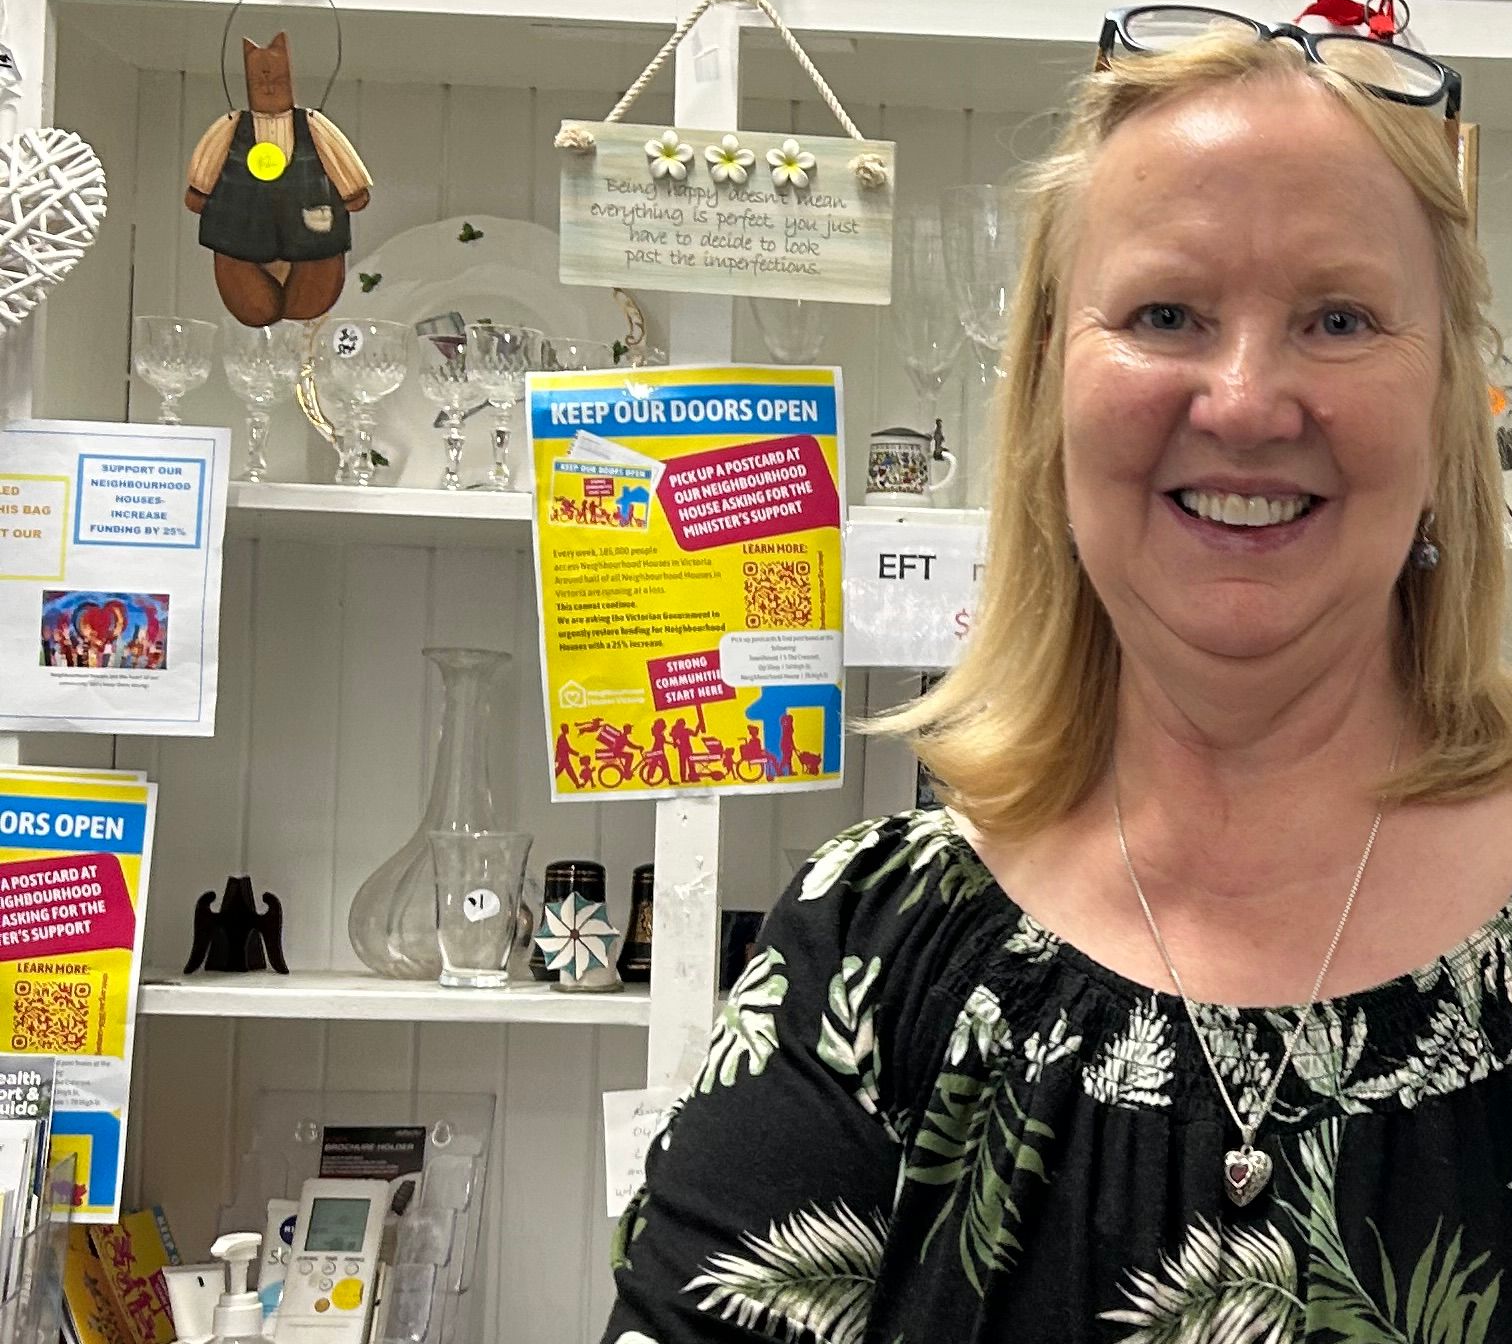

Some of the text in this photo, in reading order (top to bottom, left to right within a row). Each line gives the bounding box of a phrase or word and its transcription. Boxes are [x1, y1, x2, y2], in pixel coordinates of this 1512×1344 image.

[630, 226, 820, 255] have to decide to look
[552, 400, 817, 425] KEEP OUR DOORS OPEN
[101, 464, 182, 475] SUPPORT OUR
[669, 446, 800, 487] PICK UP A POSTCARD AT
[90, 479, 191, 490] NEIGHBOURHOOD
[674, 464, 807, 504] OUR NEIGHBOURHOOD
[678, 480, 813, 522] HOUSE ASKING FOR THE
[111, 510, 167, 520] INCREASE
[682, 501, 802, 539] MINISTER'S SUPPORT
[13, 529, 41, 538] OUR
[90, 524, 187, 536] FUNDING BY 25%
[742, 543, 808, 554] LEARN MORE:
[879, 553, 937, 581] EFT
[667, 656, 708, 671] STRONG
[665, 683, 724, 704] START HERE
[55, 814, 124, 841] OPEN
[26, 1087, 39, 1100] &
